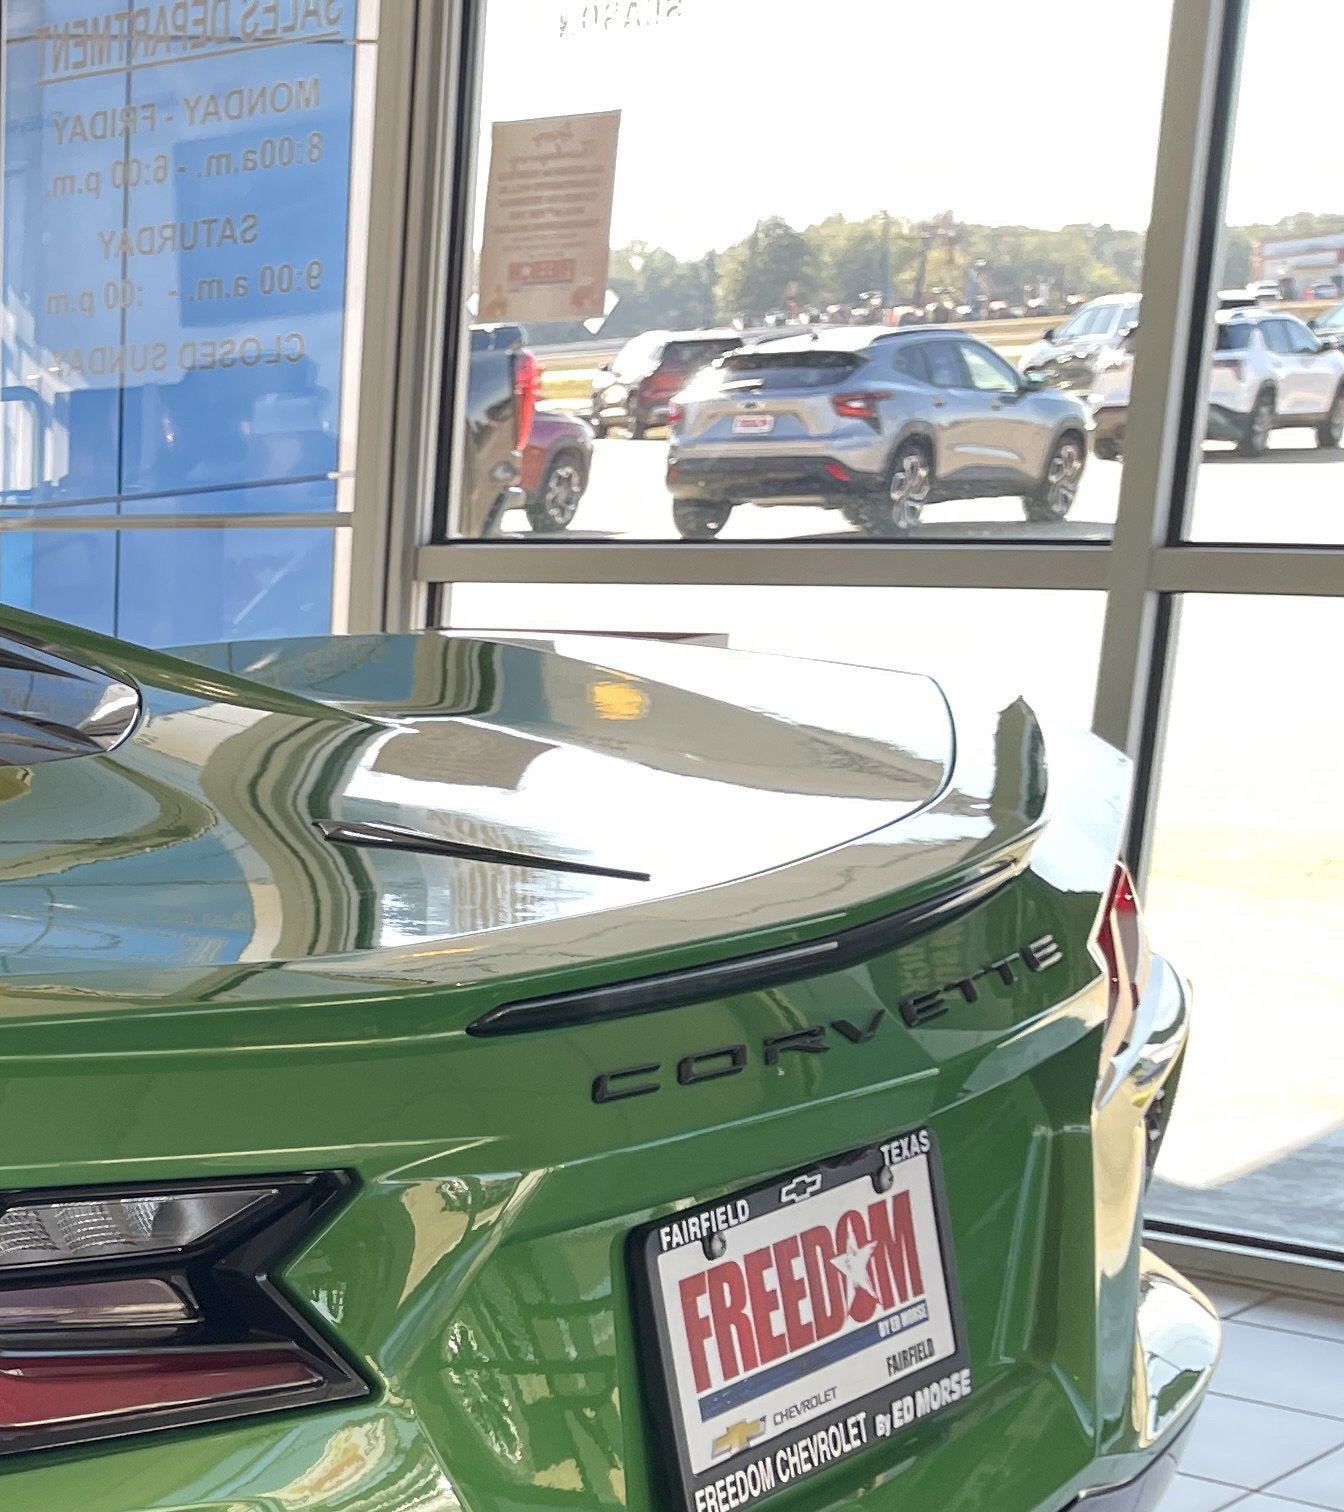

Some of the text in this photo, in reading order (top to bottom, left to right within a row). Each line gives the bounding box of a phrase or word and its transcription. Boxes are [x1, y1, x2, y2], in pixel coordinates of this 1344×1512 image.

[591, 933, 1064, 1105] CORVETTE
[659, 1129, 932, 1251] FAIRFIELD TEXAS
[678, 1189, 924, 1394] FREEDOM
[772, 1385, 838, 1427] CHEVROLET
[886, 1337, 935, 1377] FAIRFIELD
[775, 1411, 868, 1484] CHEVROLET
[891, 1395, 914, 1430] ED
[914, 1368, 973, 1419] MORSE
